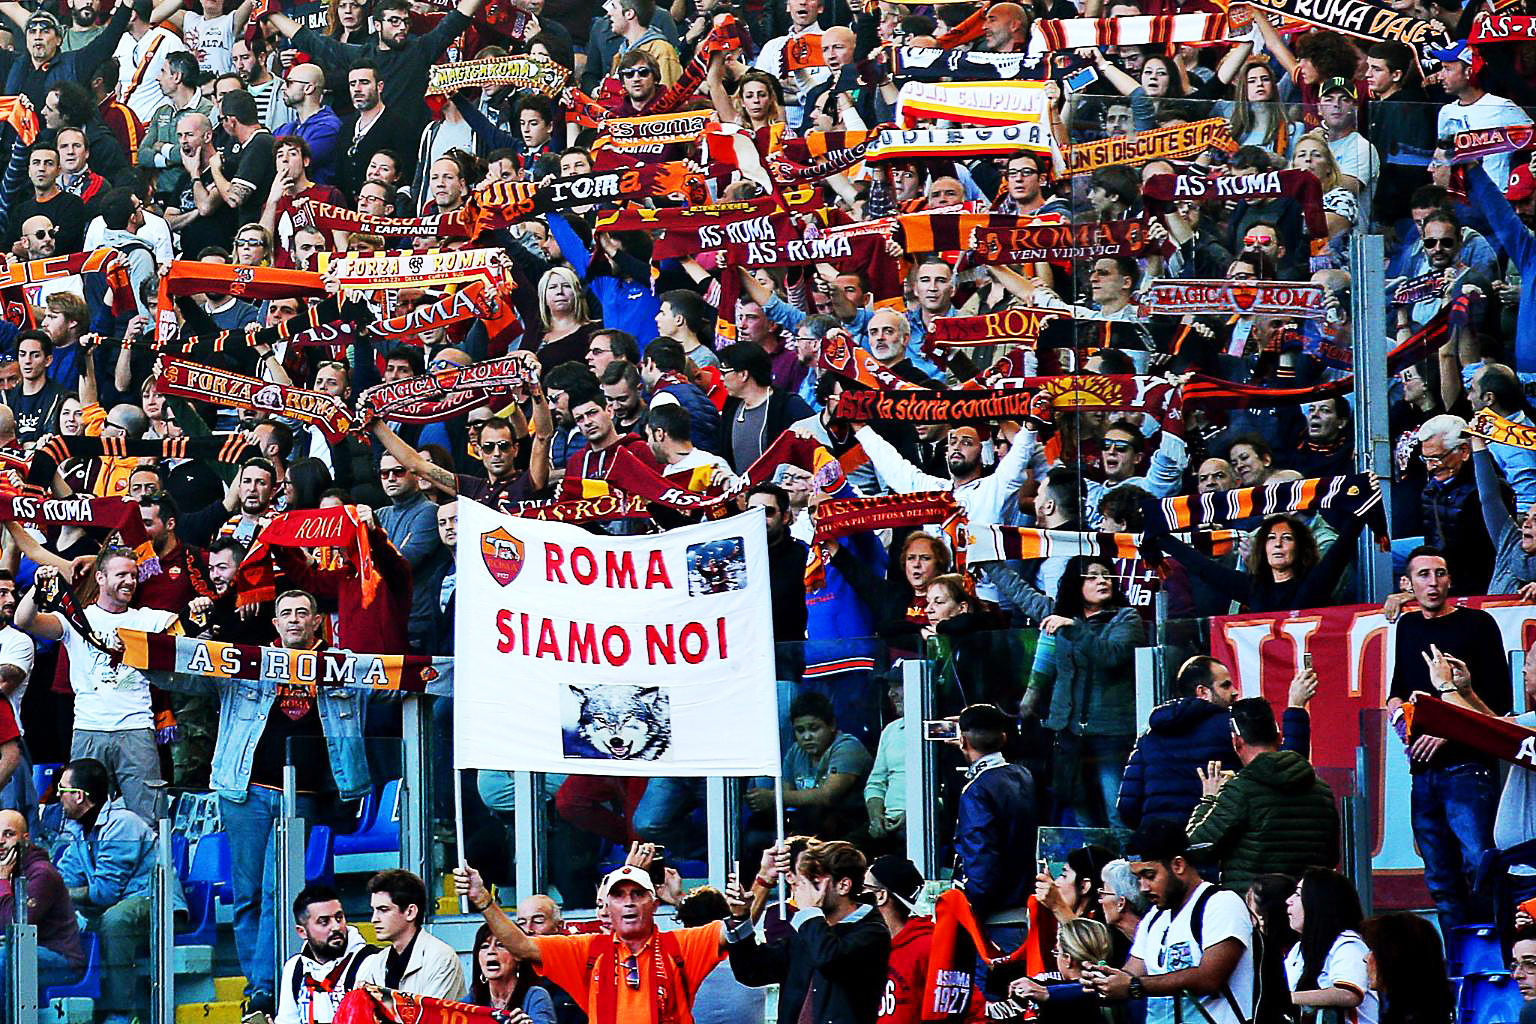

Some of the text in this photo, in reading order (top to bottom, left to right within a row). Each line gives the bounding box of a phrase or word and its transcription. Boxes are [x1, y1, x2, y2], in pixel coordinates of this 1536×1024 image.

[1369, 8, 1427, 45] DAJE
[639, 114, 705, 136] roma
[1095, 145, 1110, 164] SI
[1112, 134, 1180, 163] DISCUTE
[1184, 129, 1198, 148] SI
[550, 169, 642, 203] roma
[310, 200, 419, 230] FRANCESCO
[373, 223, 437, 235] CAPITANO
[1009, 225, 1120, 248] ROMA
[346, 252, 487, 277] FORZA ROMA
[1009, 243, 1122, 261] VENI VIDI VICI
[1157, 287, 1324, 309] MAGICA ROMA
[186, 371, 337, 420] FORZA ROMA
[369, 358, 519, 409] MAGICA ROMA
[877, 391, 894, 419] la
[897, 391, 950, 420] storia
[952, 389, 1031, 418] continua
[294, 513, 344, 541] ROMA
[543, 541, 674, 591] ROMA
[495, 608, 729, 667] SIAMO NOI
[265, 650, 390, 686] ROMA
[933, 987, 971, 1015] 1927
